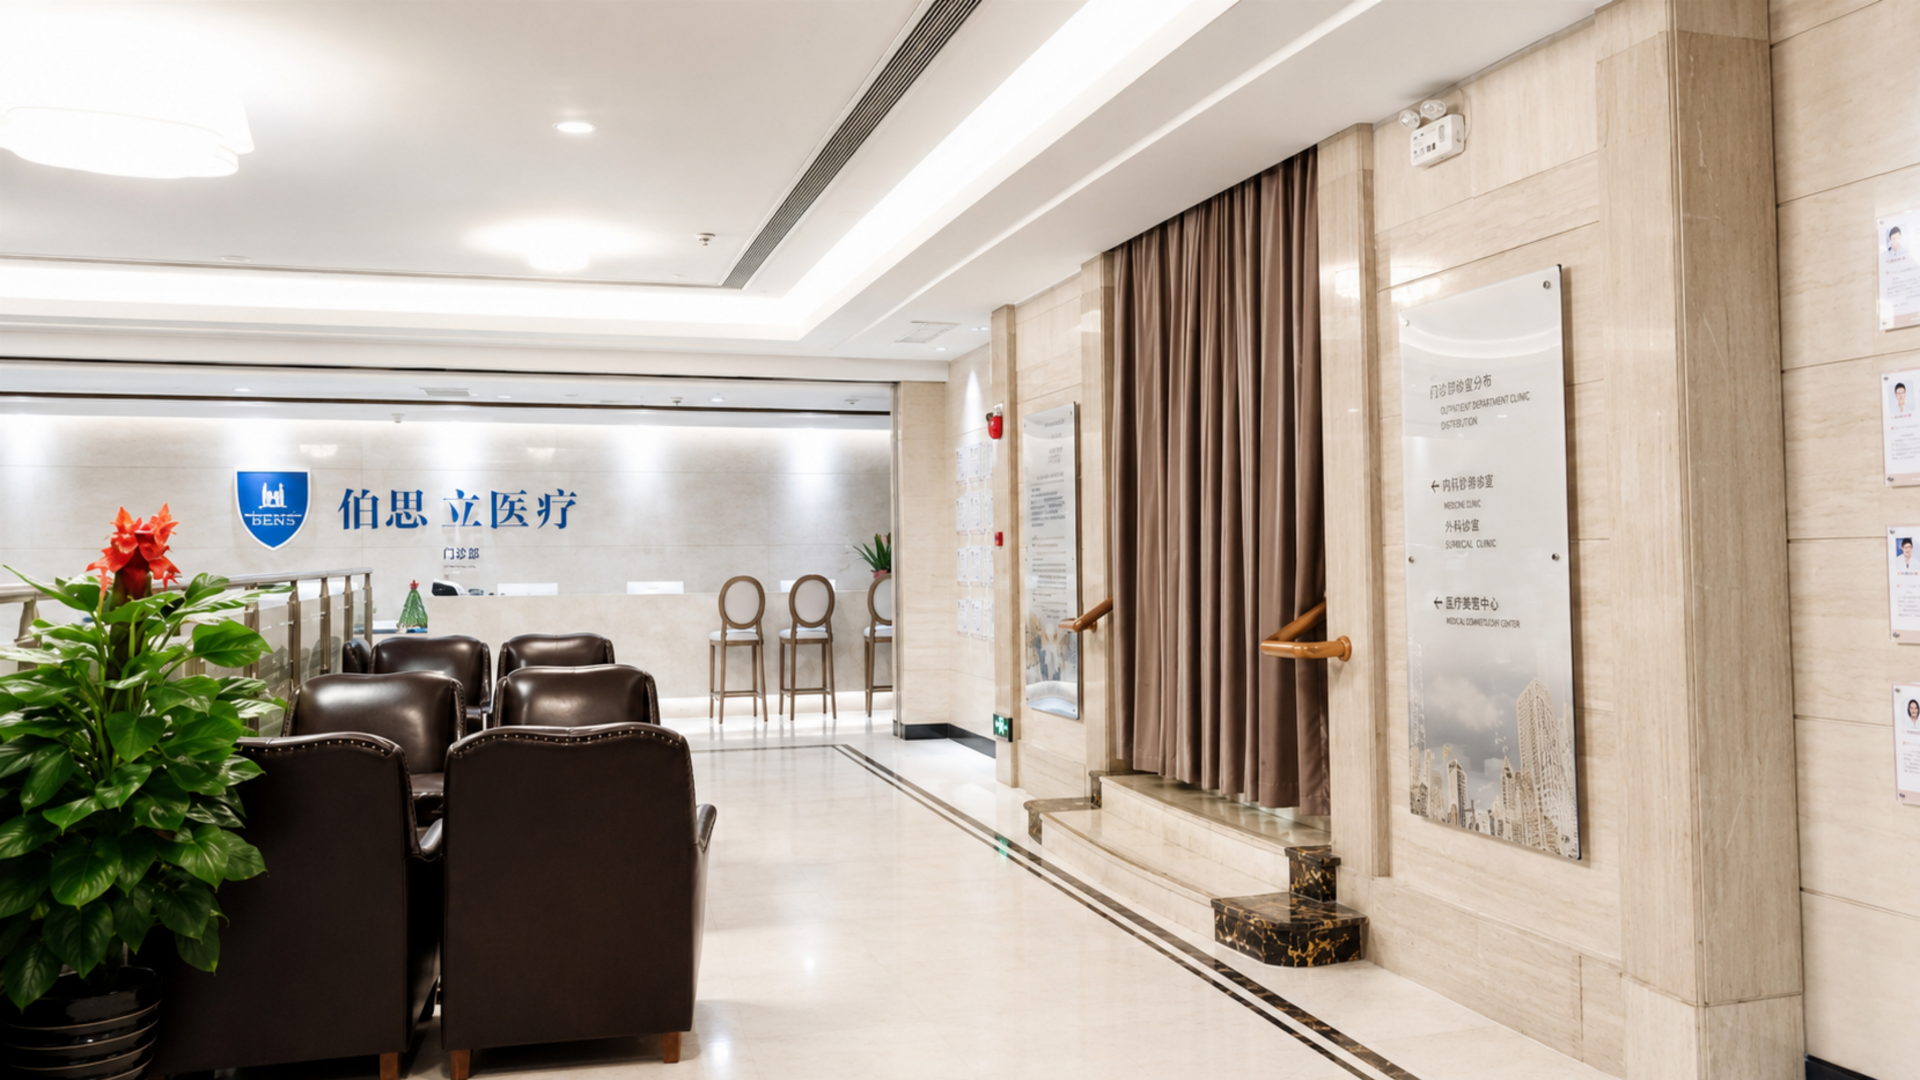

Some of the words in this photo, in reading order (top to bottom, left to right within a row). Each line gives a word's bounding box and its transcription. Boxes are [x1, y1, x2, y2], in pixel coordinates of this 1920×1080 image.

[1510, 391, 1531, 404] CLINIC
[338, 488, 577, 530] 伯思立医疗
[1476, 539, 1497, 548] CLINIC
